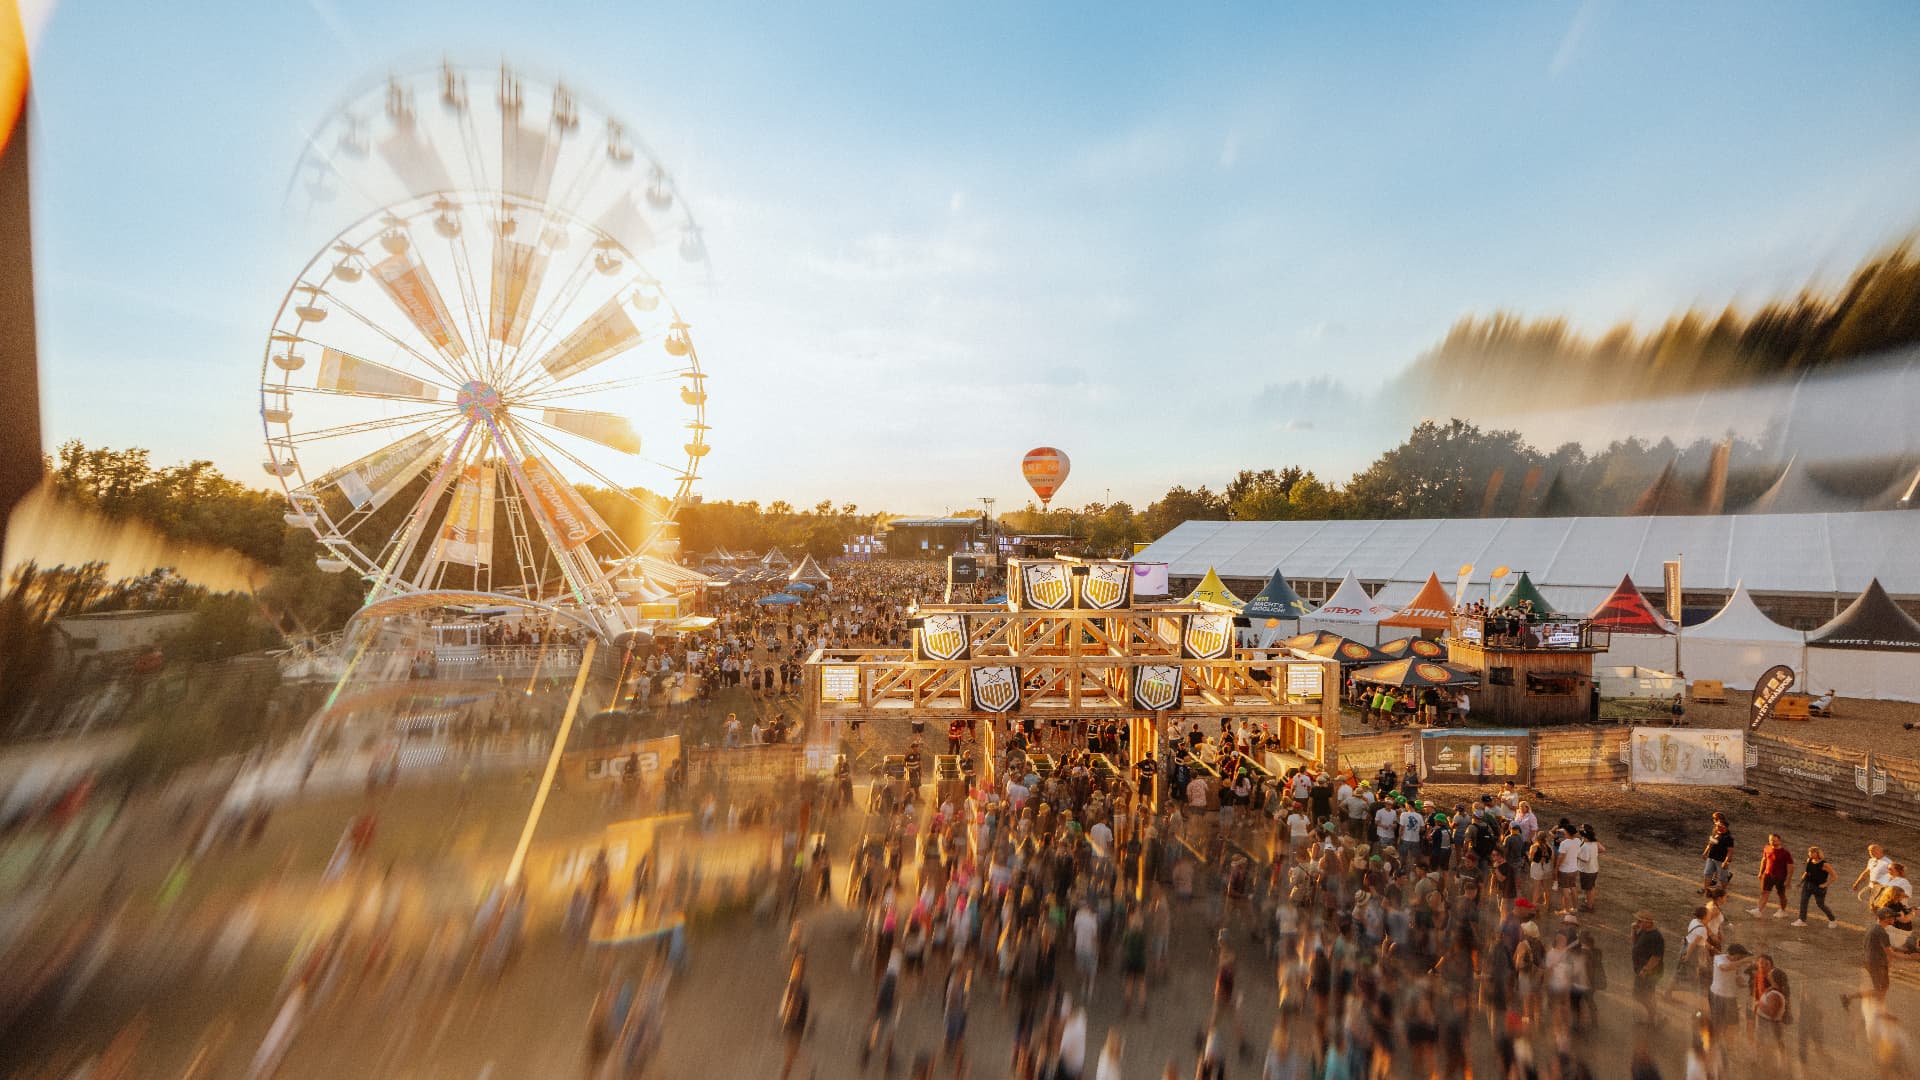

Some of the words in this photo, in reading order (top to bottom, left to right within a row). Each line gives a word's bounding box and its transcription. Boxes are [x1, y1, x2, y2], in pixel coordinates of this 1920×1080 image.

[1032, 579, 1064, 605] WDB
[1089, 579, 1120, 605] WDB
[1323, 606, 1362, 616] STEYR
[1402, 608, 1448, 618] STIHL
[928, 631, 960, 657] WDB
[1192, 628, 1221, 655] WDB
[980, 682, 1012, 708] WDB
[1141, 679, 1172, 706] WDB
[1771, 754, 1841, 776] woodstock
